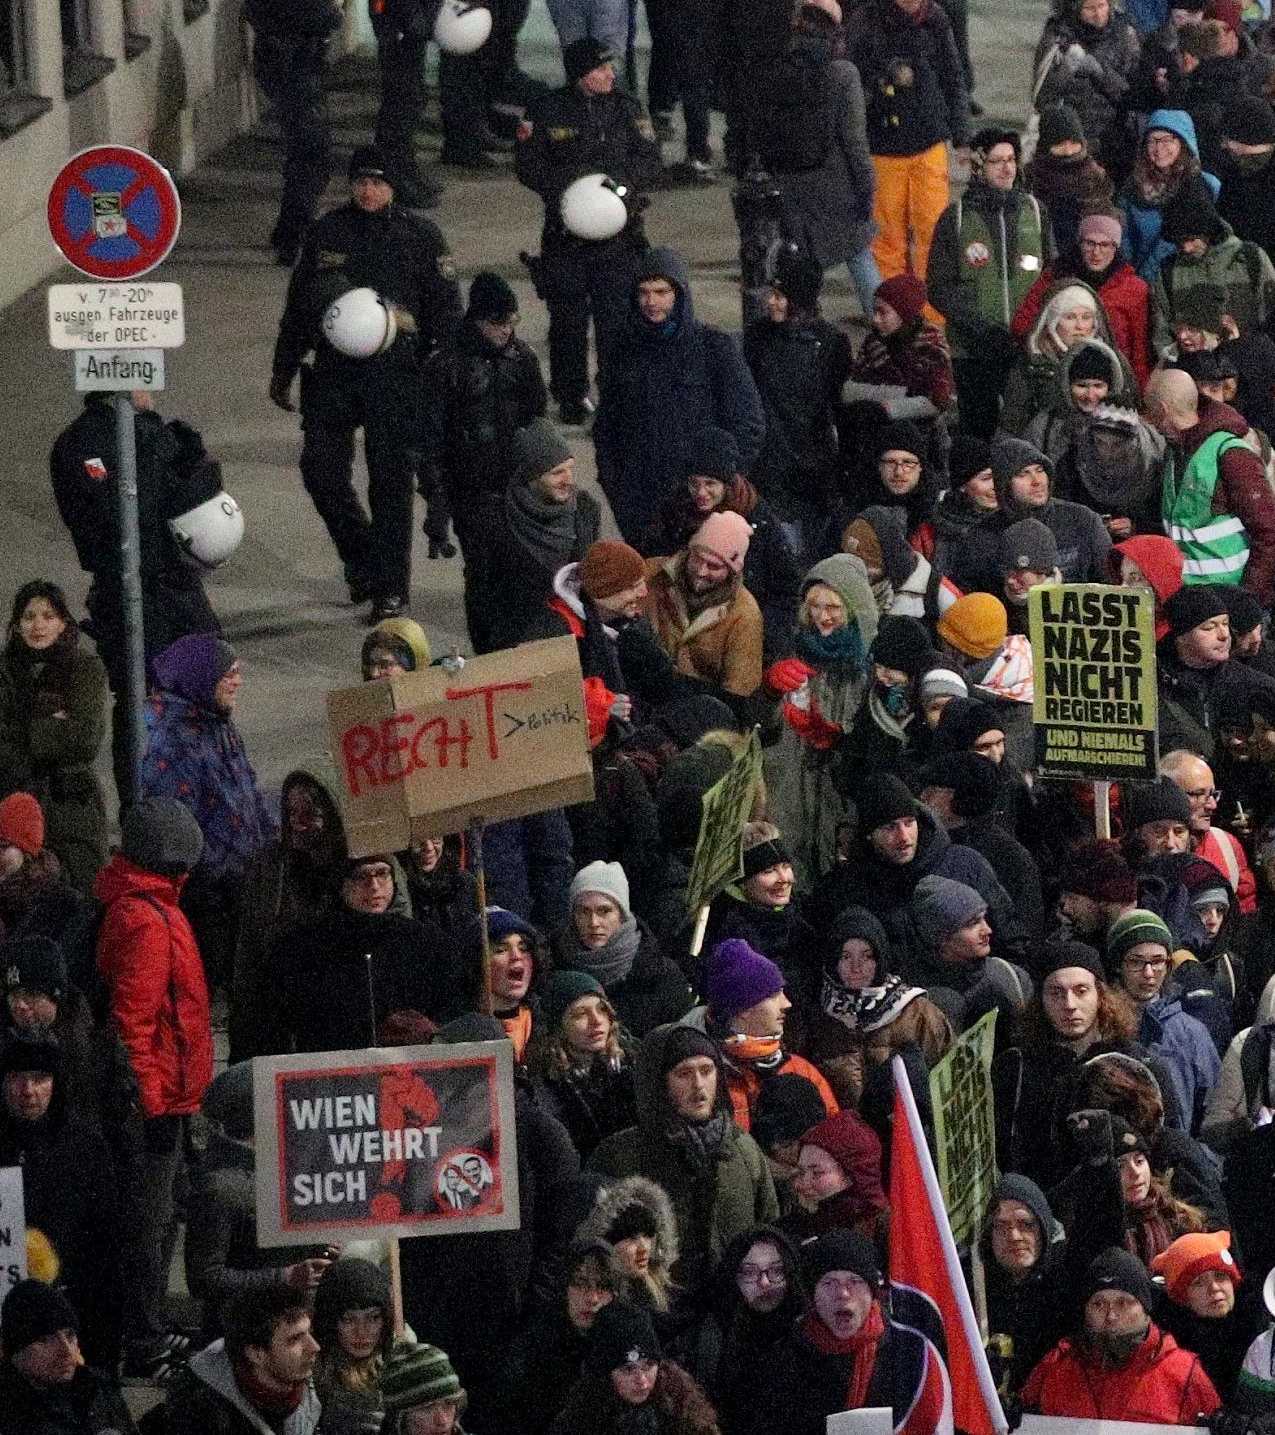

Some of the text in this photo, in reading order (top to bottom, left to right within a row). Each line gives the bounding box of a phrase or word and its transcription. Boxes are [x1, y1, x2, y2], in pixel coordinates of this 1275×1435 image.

[54, 306, 179, 325] ausgen. Fahrzeuge
[86, 327, 149, 343] der OPEC
[85, 354, 154, 384] Anfang
[1041, 591, 1140, 628] LASST
[1043, 626, 1143, 665] NAZIS
[1044, 661, 1143, 701] NICHT
[1045, 697, 1144, 726] REGIEREN
[341, 681, 532, 797] RECHT
[1046, 728, 1145, 752] UND NIEMALS
[290, 1093, 377, 1131] WIEN
[329, 1126, 443, 1166] WEHRT
[293, 1169, 368, 1207] SICH
